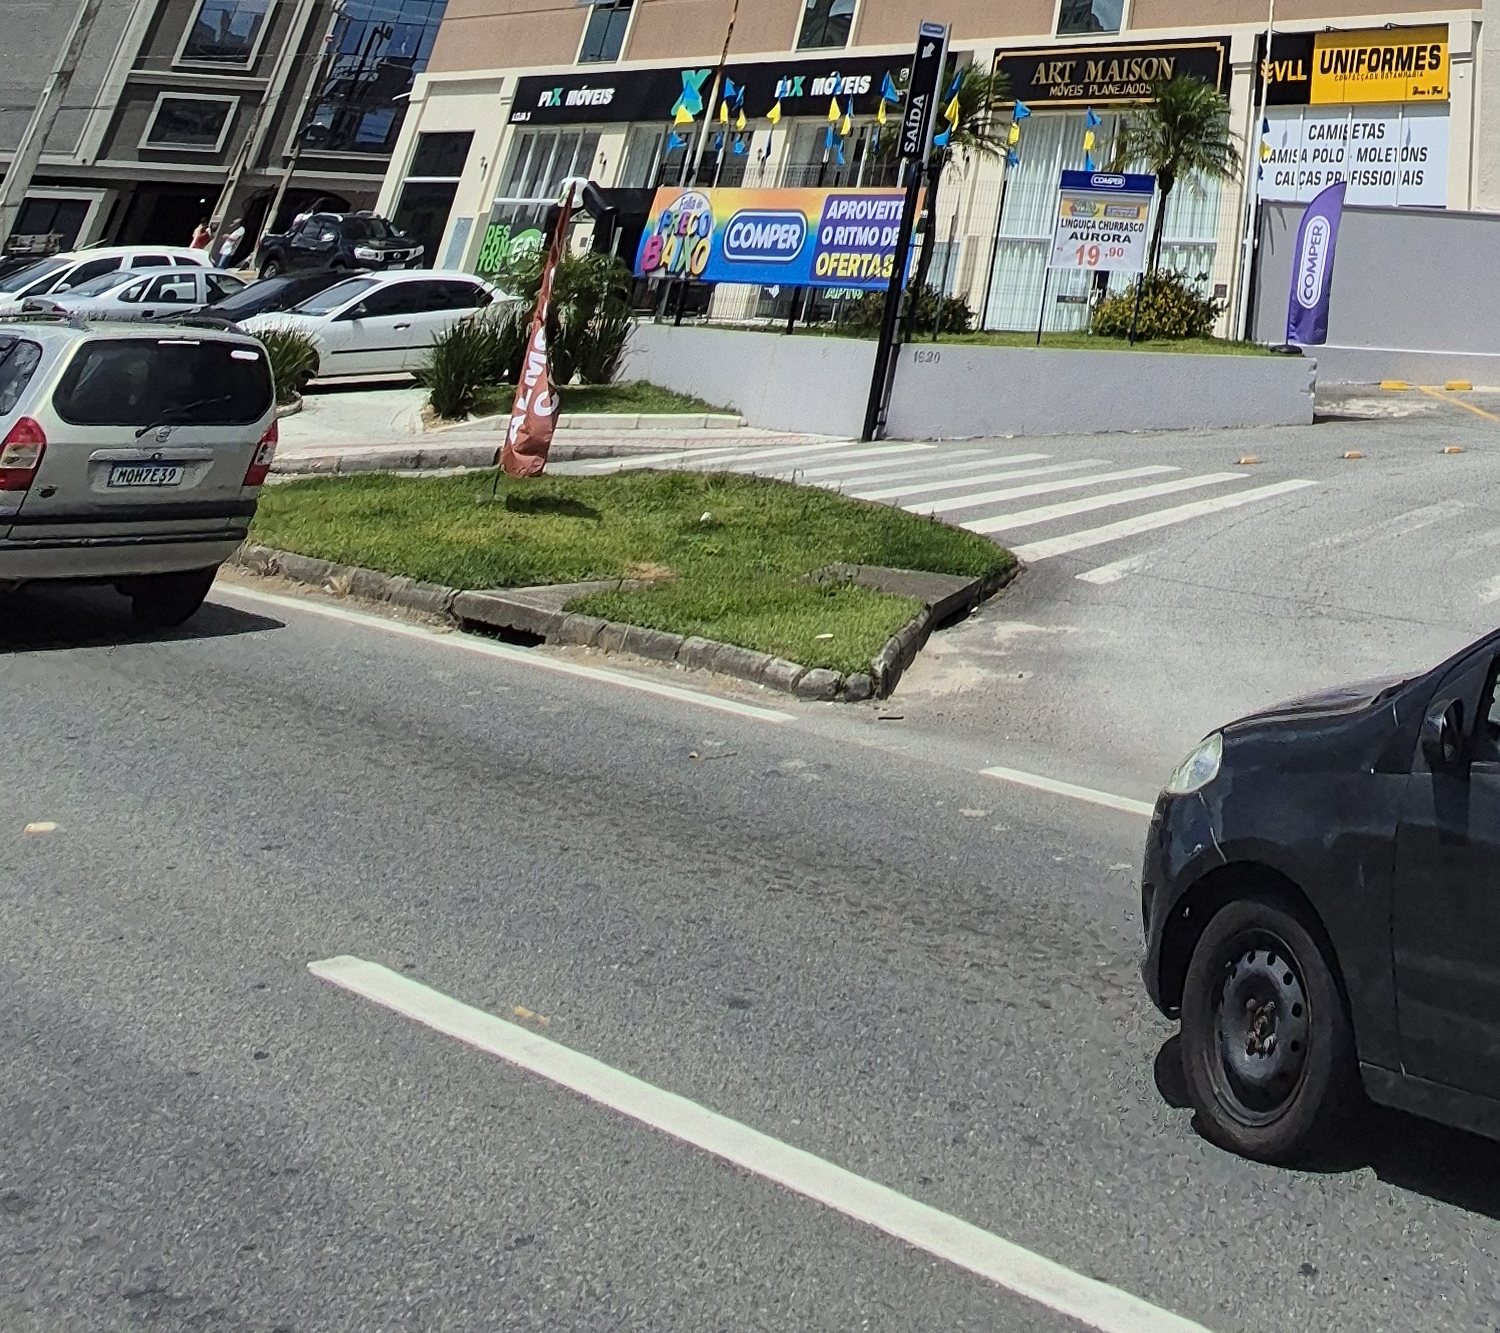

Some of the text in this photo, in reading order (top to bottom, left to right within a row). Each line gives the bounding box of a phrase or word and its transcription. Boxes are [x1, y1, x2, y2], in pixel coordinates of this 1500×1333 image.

[1030, 57, 1176, 85] ART MAISON
[1274, 60, 1308, 82] VLL
[1319, 44, 1442, 75] UNIFORMES
[537, 85, 616, 108] PIX MÓVEIS
[1049, 82, 1152, 97] MÓVEIS PLANEJADOS
[904, 94, 925, 153] SAÍDA
[1308, 123, 1386, 140] CAMISETAS
[826, 200, 905, 220] APROVEITE
[729, 222, 800, 250] COMPER
[821, 226, 900, 246] O RITMO DE
[1060, 218, 1145, 233] LINGUIÇA CHURRASCO
[1069, 231, 1132, 244] AURORA
[641, 235, 711, 277] BAIXO
[815, 253, 895, 278] OFERTAS
[1303, 225, 1324, 301] COMPER
